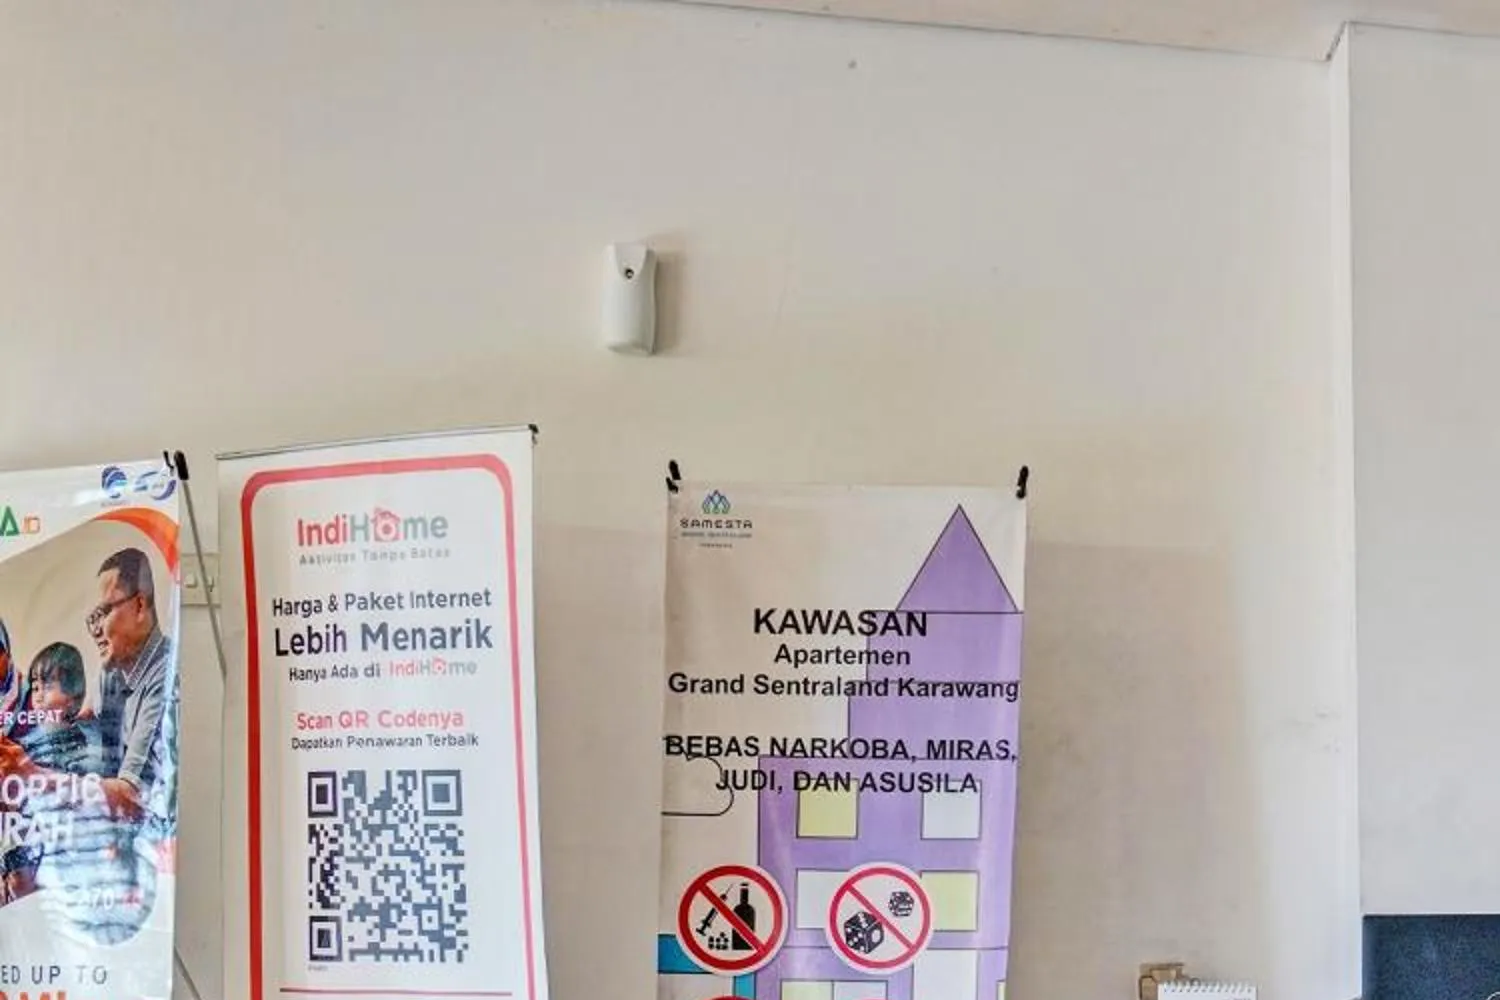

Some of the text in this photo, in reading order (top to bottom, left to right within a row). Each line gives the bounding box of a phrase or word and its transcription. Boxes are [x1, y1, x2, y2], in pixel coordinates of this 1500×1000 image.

[297, 508, 449, 547] IndiHome
[680, 519, 753, 529] SAMESTA
[272, 587, 493, 619] Harga & Paket Internet
[754, 608, 927, 637] KAWASAN
[275, 618, 493, 656] Lebih Menarik
[774, 643, 911, 668] Apartemen
[289, 656, 477, 683] Hanya Ada di IndiHome
[668, 672, 1019, 703] Grand Sentraland Karawang
[17, 709, 63, 725] CEPAT
[297, 709, 465, 730] Scan QR Codenya
[291, 733, 479, 751] Dapatkan Penawaran Terbaik
[664, 735, 1016, 763] BEBAS NARKOBA, MIRAS,
[2, 772, 101, 808] OPTIC
[716, 769, 978, 794] JUDI, DAN ASUSILA
[31, 966, 61, 986] UP
[76, 965, 107, 986] TO
